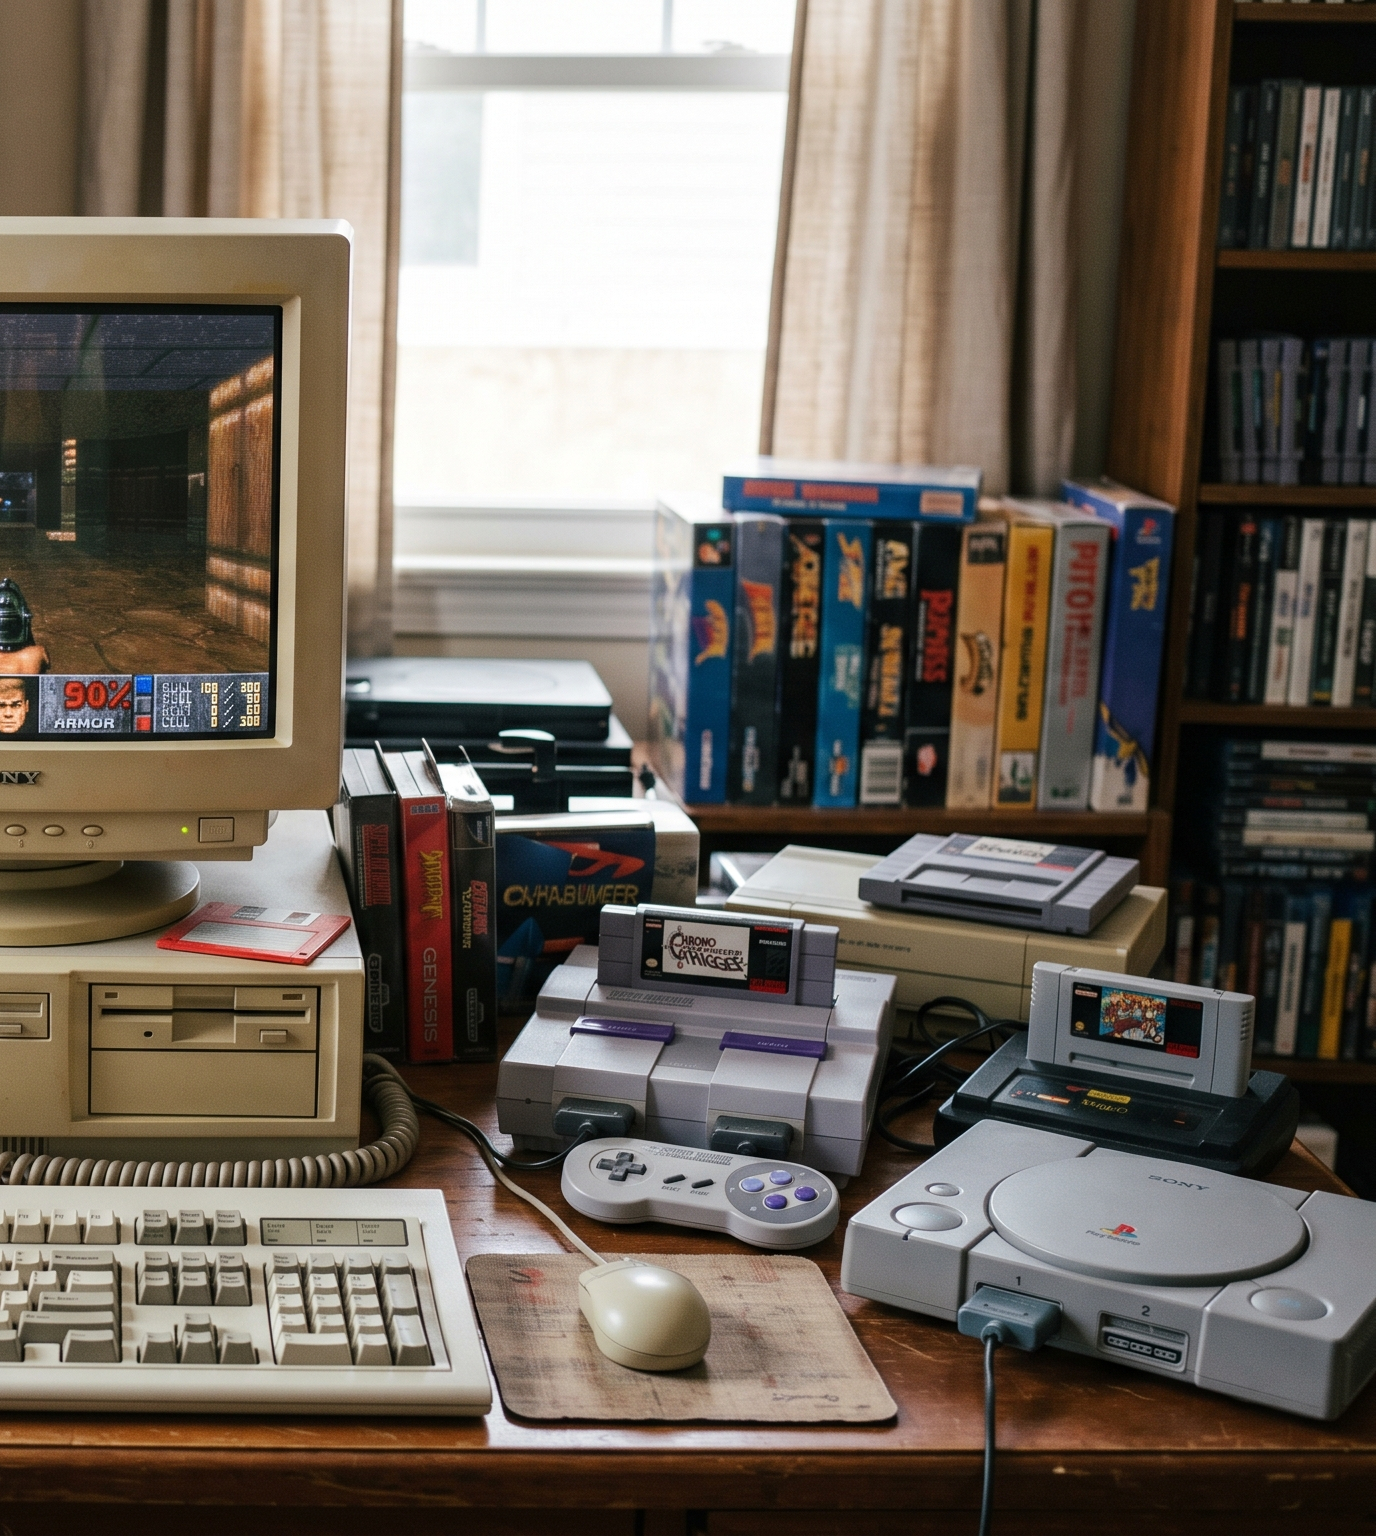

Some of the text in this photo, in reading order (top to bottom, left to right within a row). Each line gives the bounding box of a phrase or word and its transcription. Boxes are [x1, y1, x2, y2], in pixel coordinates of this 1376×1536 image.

[63, 680, 132, 711] 90%
[54, 717, 115, 729] ARMOR
[424, 947, 438, 1043] GENESIS
[1015, 1276, 1022, 1287] 1
[1140, 1305, 1152, 1317] 2
